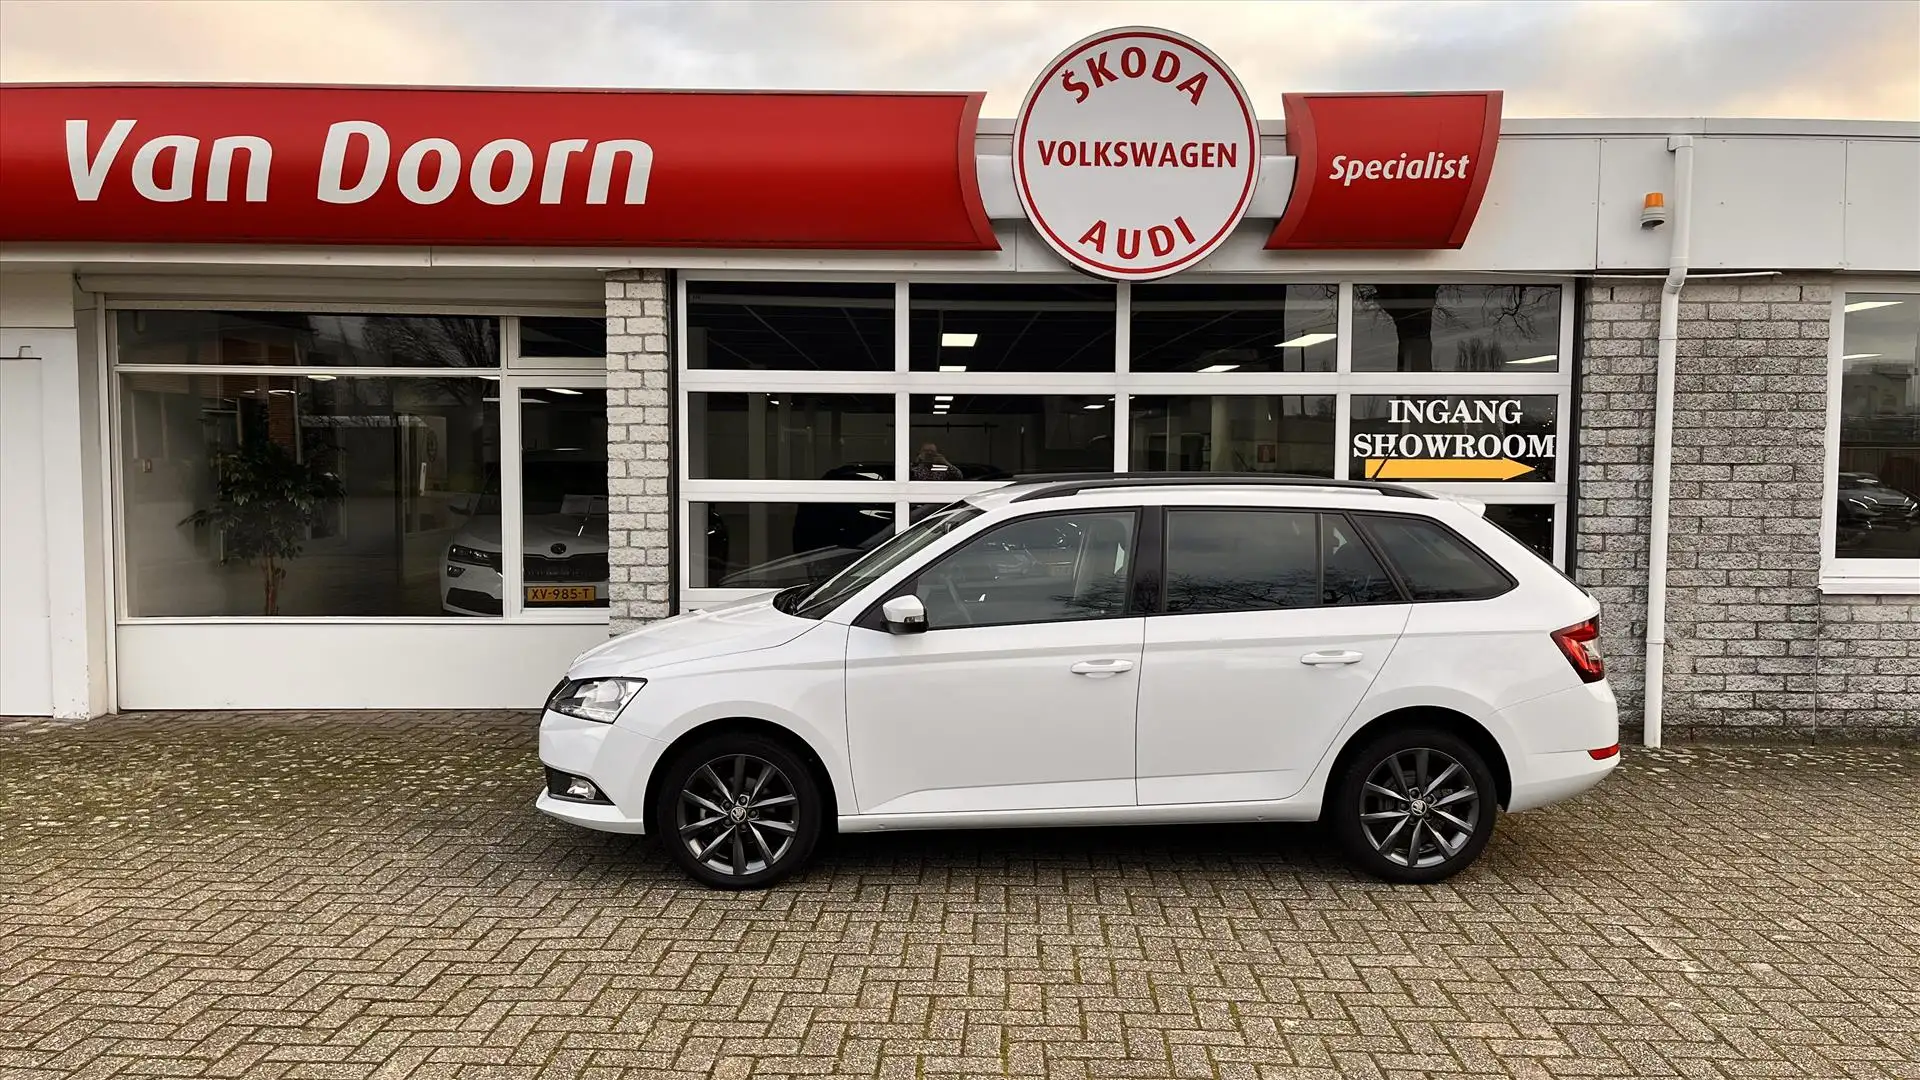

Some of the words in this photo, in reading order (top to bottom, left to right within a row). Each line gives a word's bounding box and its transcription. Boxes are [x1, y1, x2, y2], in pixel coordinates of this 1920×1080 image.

[1061, 46, 1209, 106] ŠKODA
[66, 120, 273, 203] Van
[318, 120, 653, 204] Doorn
[1038, 140, 1238, 168] VOLKSWAGEN
[1329, 152, 1469, 186] Specialist
[1078, 216, 1197, 260] AUDI
[1388, 400, 1523, 424] INGANG
[1353, 433, 1556, 458] SHOWROOM
[531, 588, 590, 600] XV-985-T
